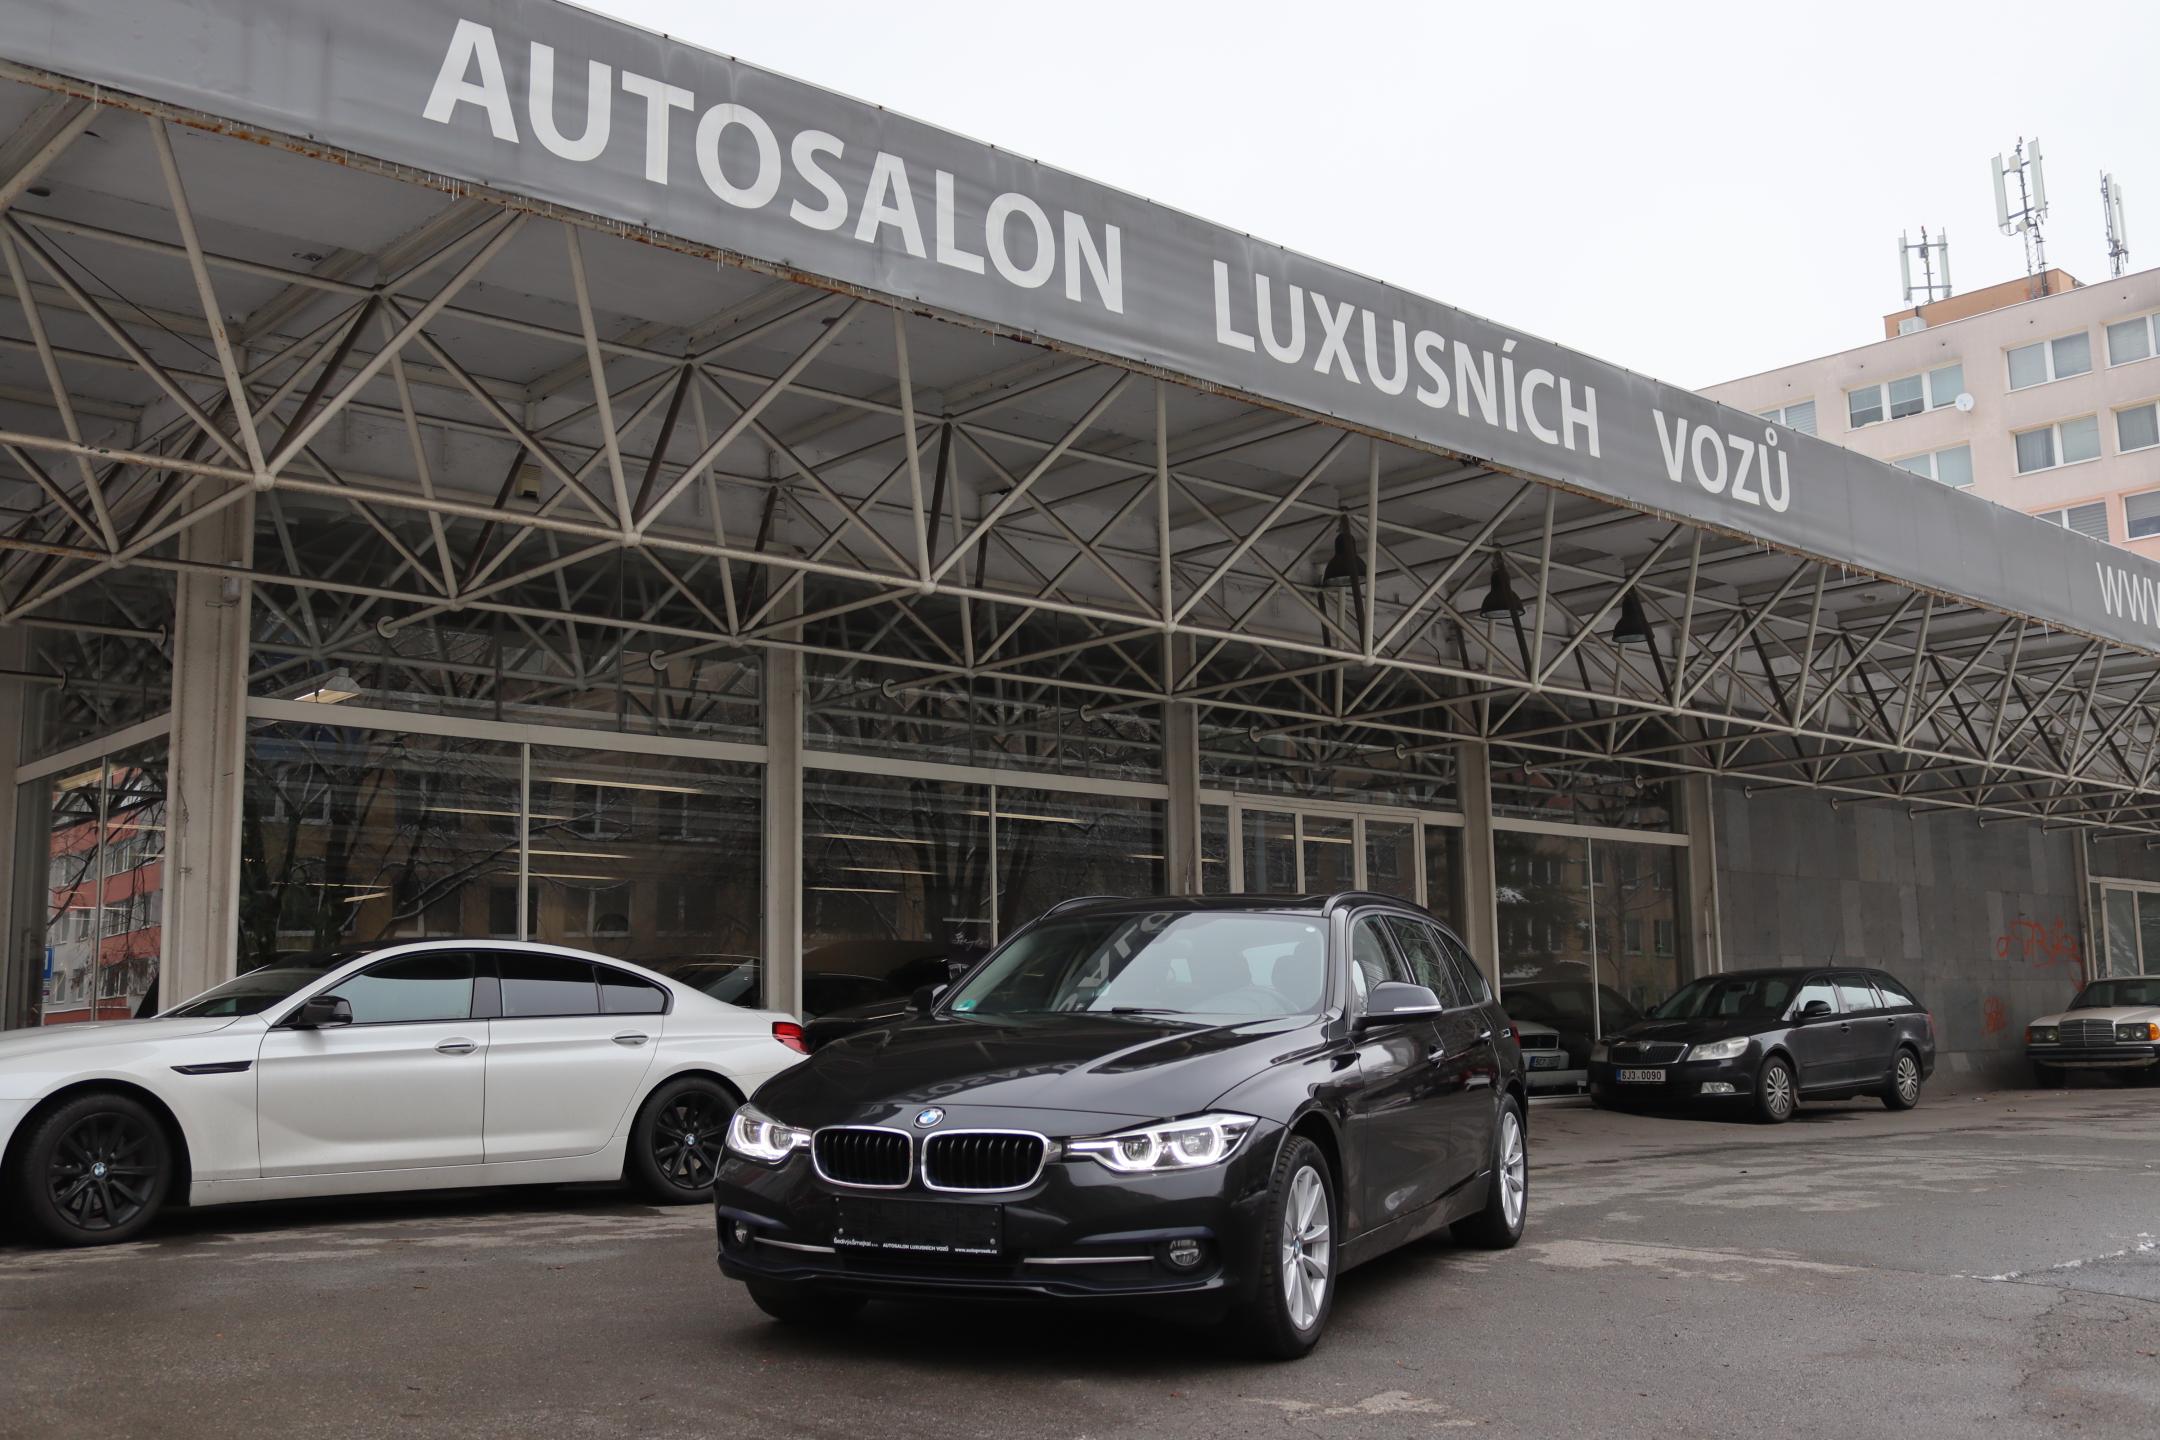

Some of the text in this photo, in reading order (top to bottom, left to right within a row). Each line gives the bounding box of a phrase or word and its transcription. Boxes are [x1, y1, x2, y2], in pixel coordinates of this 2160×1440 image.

[422, 18, 1790, 513] AUTOSALON LUXUSNÍCH VOZŮ
